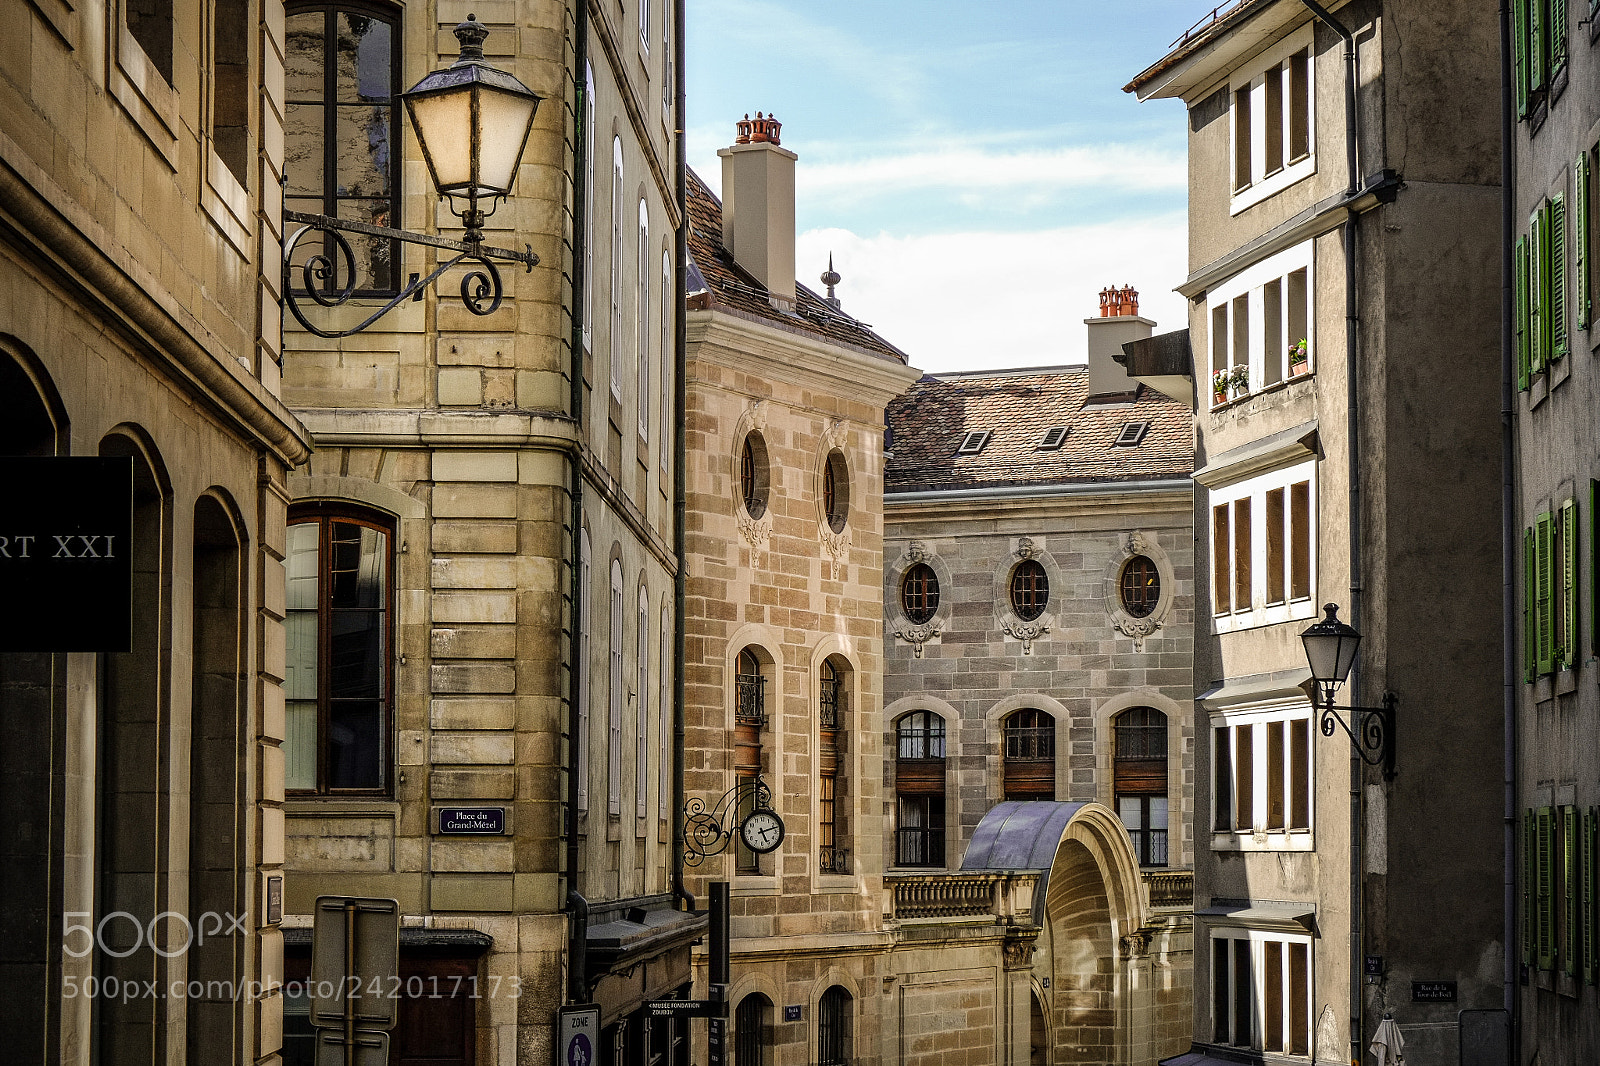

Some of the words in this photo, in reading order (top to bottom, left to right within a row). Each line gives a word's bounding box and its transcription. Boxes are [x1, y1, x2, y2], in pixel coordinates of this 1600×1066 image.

[51, 535, 116, 558] XXI
[456, 812, 475, 820] Place
[476, 812, 488, 820] du
[447, 820, 496, 829] Grand-Mézel
[571, 1016, 589, 1028] ZONE
